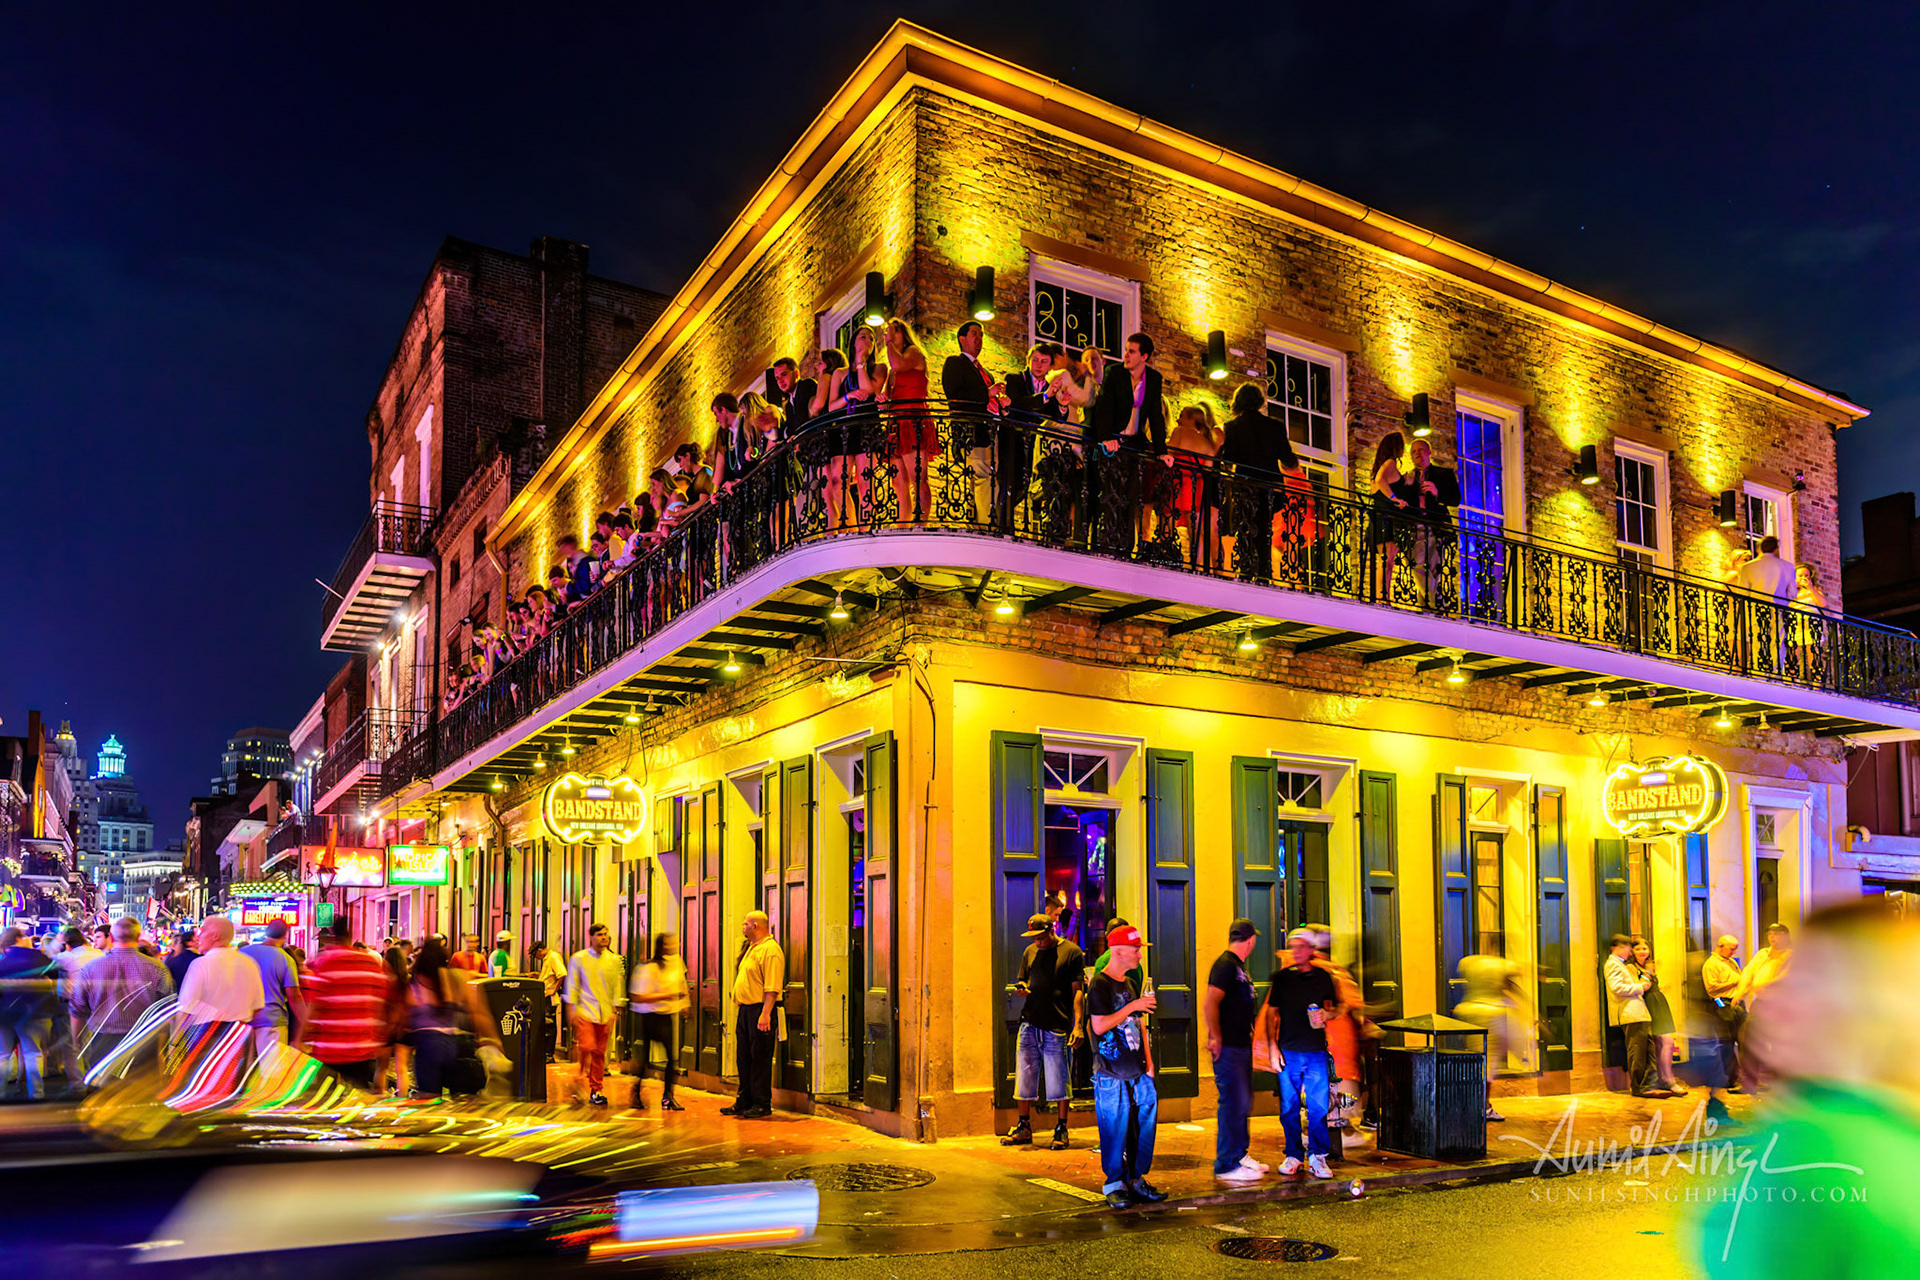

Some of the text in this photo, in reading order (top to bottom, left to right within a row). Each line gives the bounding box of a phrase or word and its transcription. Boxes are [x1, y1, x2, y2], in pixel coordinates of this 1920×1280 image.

[1606, 784, 1703, 811] BANDSTAND
[554, 799, 641, 821] BANDSTAND
[393, 852, 443, 863] TROPICA
[408, 861, 431, 870] ISLE
